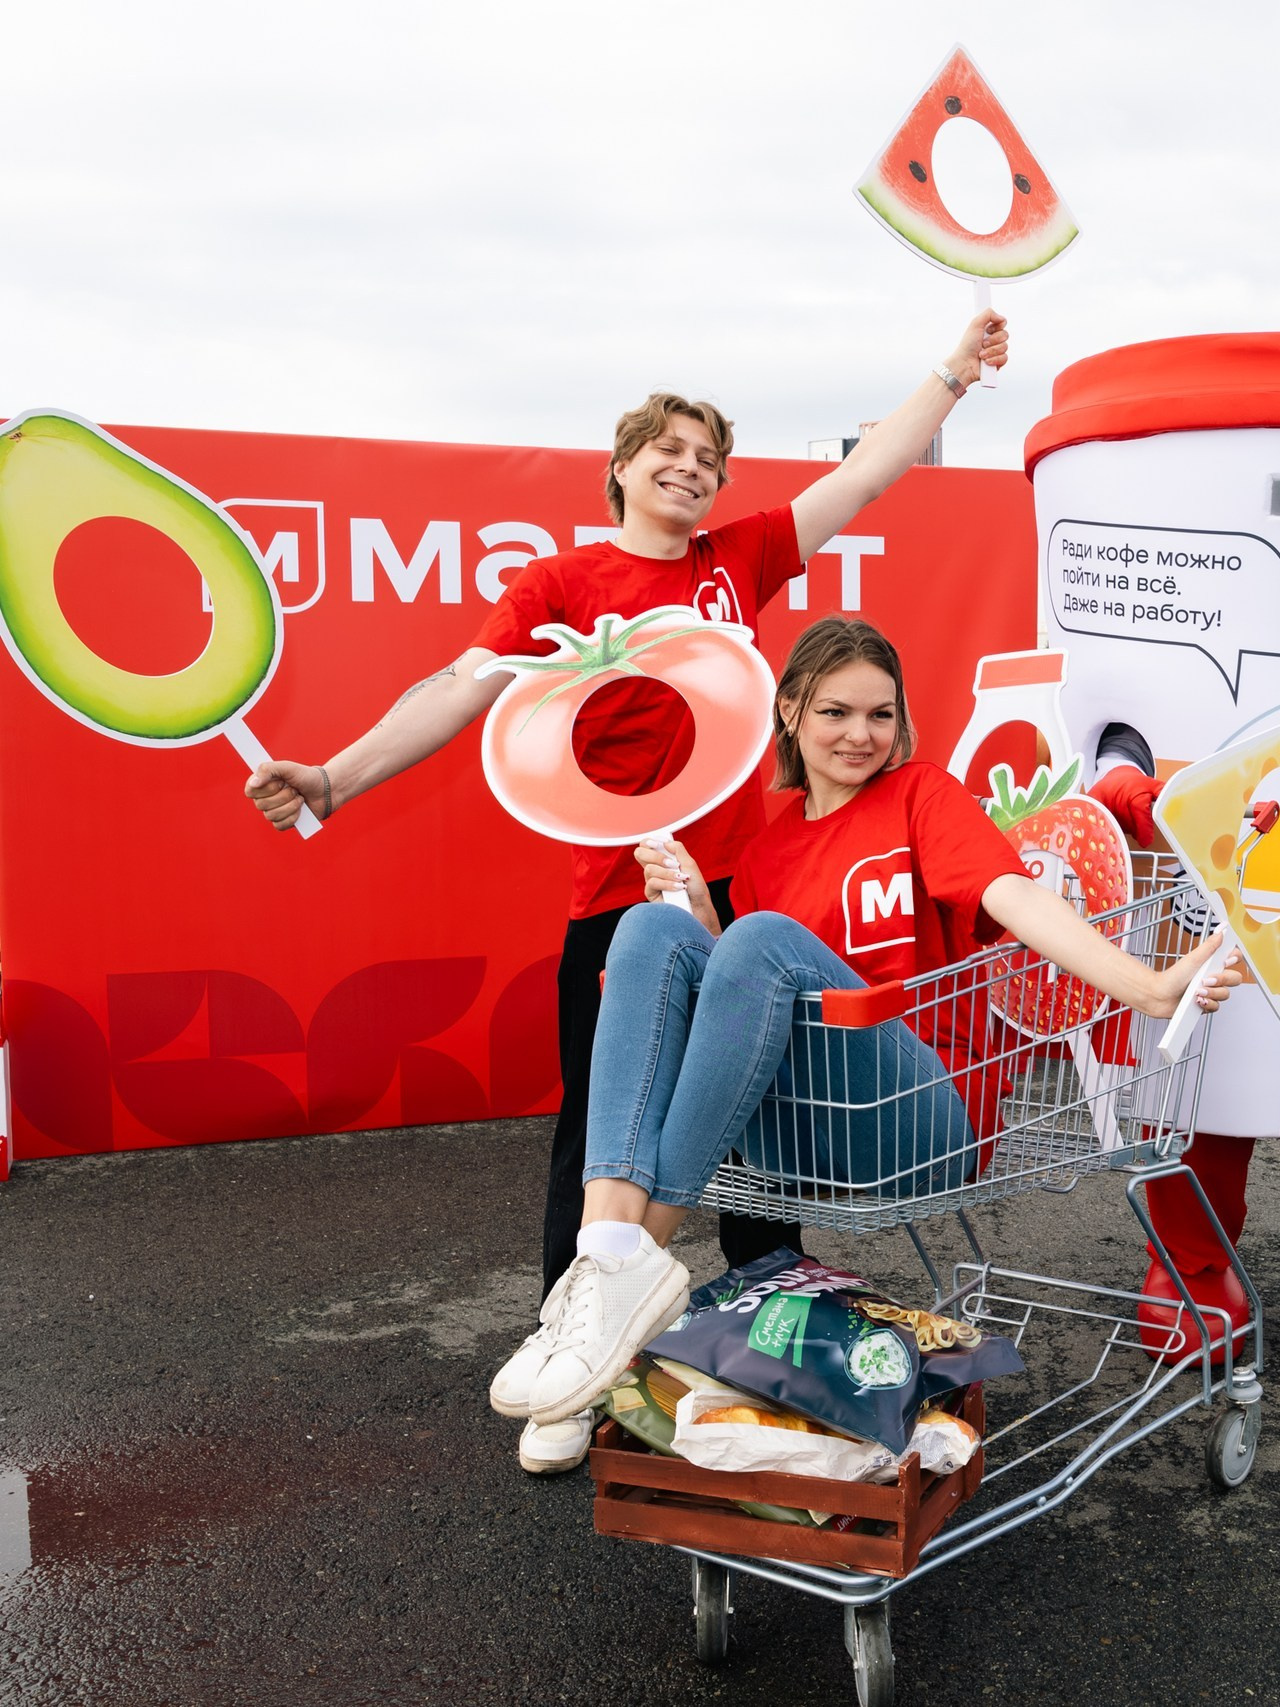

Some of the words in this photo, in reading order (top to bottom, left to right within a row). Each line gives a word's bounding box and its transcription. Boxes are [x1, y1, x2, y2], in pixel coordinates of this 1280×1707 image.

[1062, 538, 1092, 561] Ради
[1097, 543, 1149, 568] кофе
[1156, 550, 1242, 571] можно
[1062, 566, 1100, 587] пойти
[1105, 574, 1129, 590] на
[1136, 576, 1182, 596] всё.
[1063, 593, 1099, 614] Даже
[1103, 601, 1126, 617] на
[1131, 603, 1222, 631] работу!
[861, 872, 914, 924] М
[755, 1297, 789, 1346] Сметана
